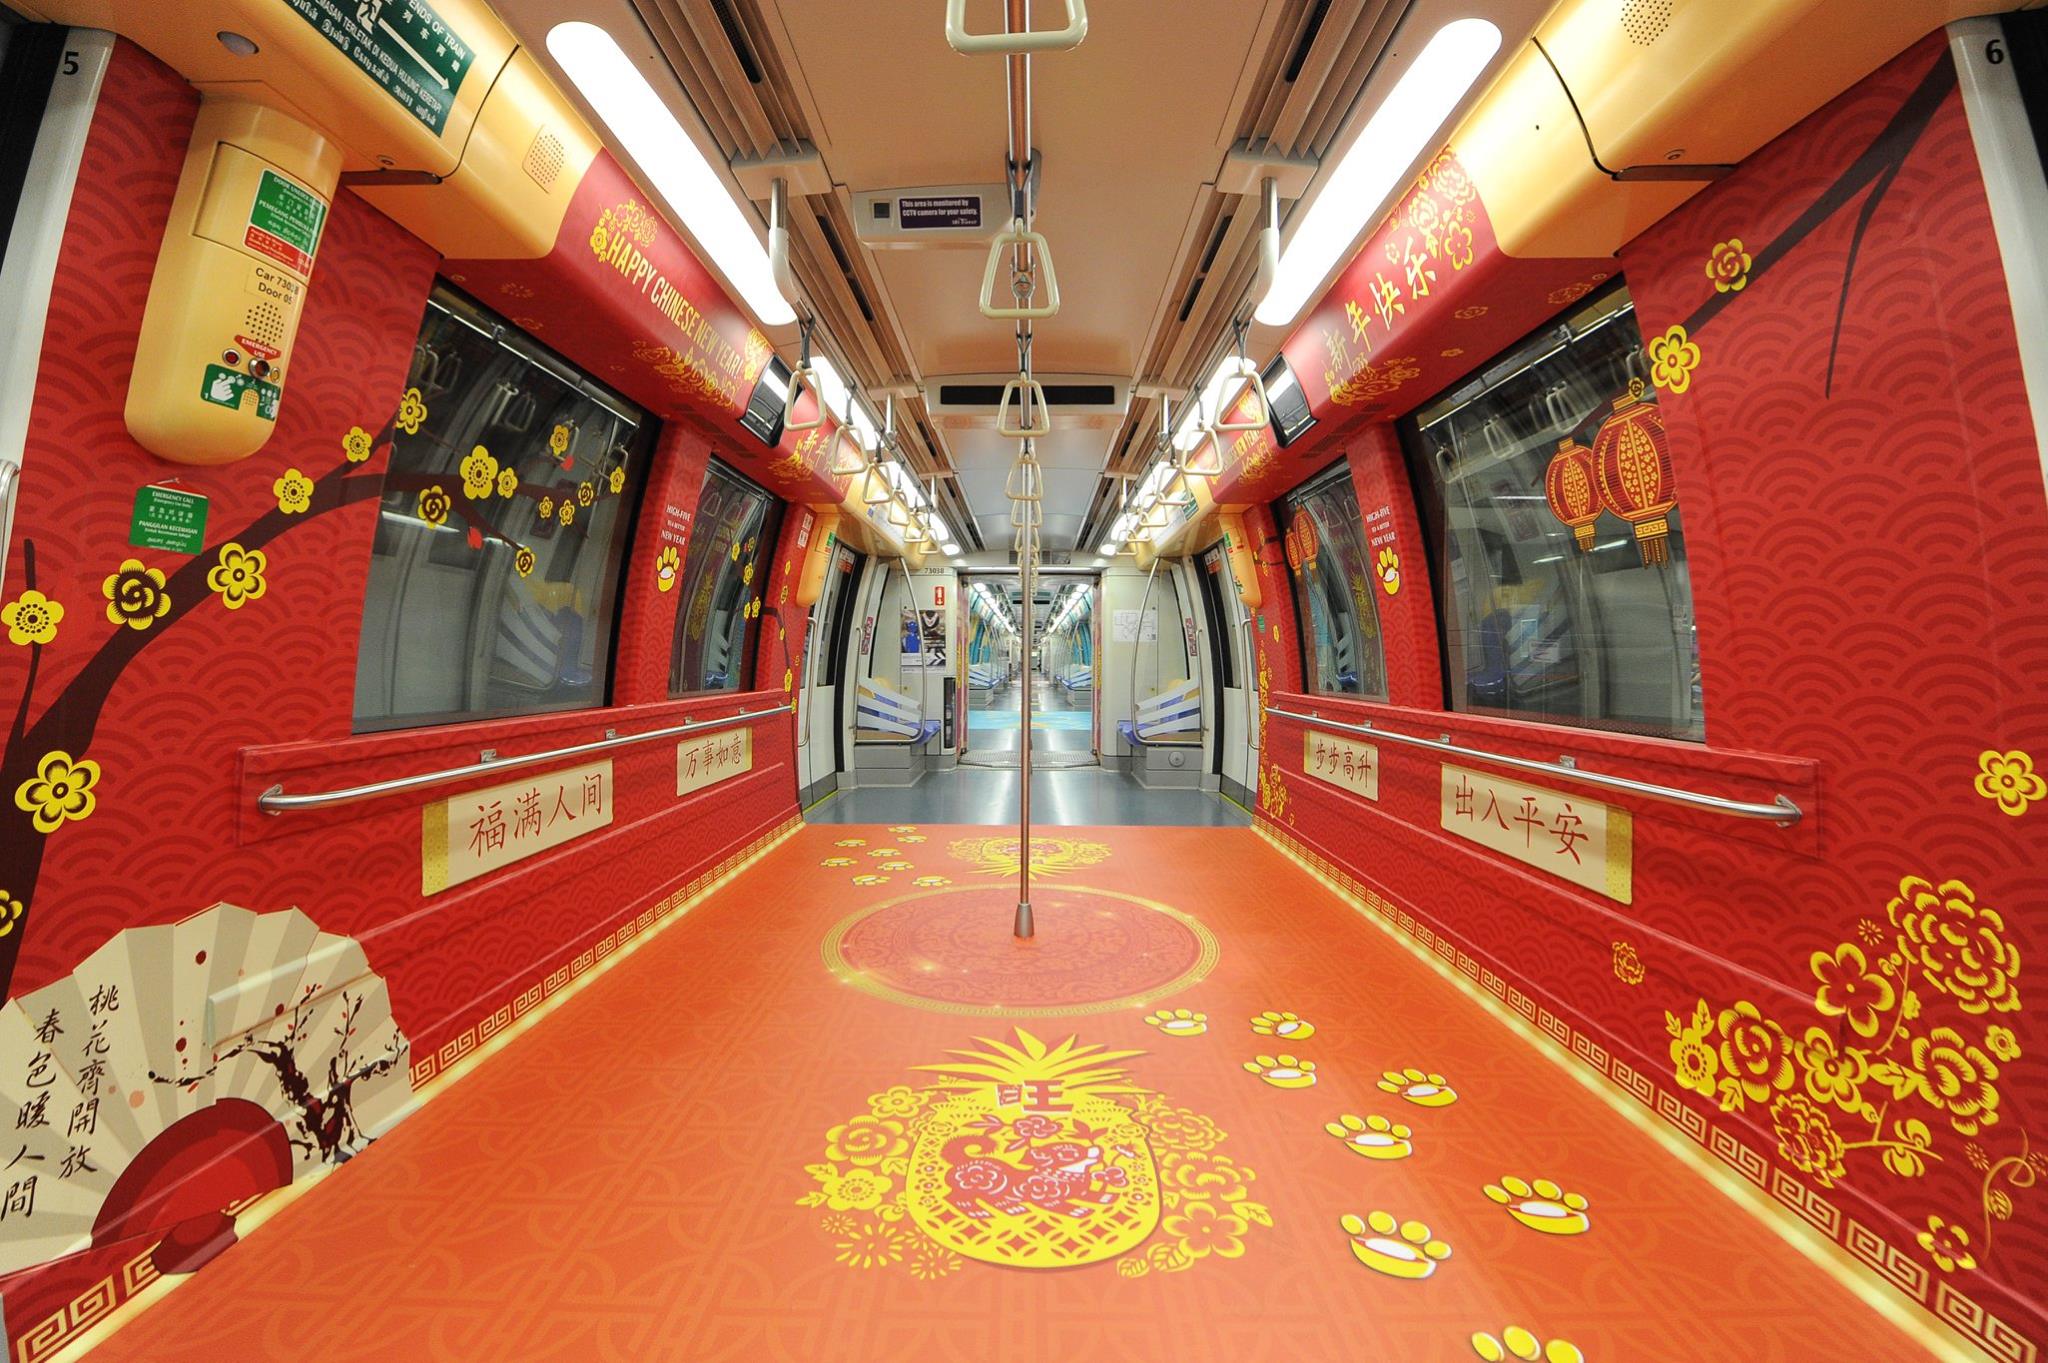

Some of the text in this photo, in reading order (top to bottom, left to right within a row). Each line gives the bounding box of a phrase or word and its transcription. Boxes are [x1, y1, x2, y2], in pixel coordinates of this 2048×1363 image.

[342, 16, 373, 50] TERLETAK
[371, 44, 381, 57] DI
[379, 50, 398, 75] KEDUA
[408, 0, 467, 59] ENDS OF TRAIN
[1986, 39, 2004, 64] 6
[63, 51, 79, 75] 5
[902, 209, 917, 217] CCTV
[933, 199, 961, 207] monitored
[962, 199, 969, 207] by
[255, 267, 274, 282] Car
[258, 281, 282, 299] Door
[606, 231, 744, 380] HAPPY CHINESE NEW YEAR!
[1322, 236, 1438, 371] 新年快乐
[240, 337, 278, 355] EMERGENCY
[152, 490, 194, 504] EMERGENCY CALL
[684, 733, 743, 779] 万事如意
[1315, 738, 1372, 789] 步步高升
[468, 773, 602, 858] 福满人间
[1455, 774, 1590, 866] 出入平安
[57, 983, 120, 1181] 桃花齊開放
[995, 1079, 1075, 1112] 旺
[0, 1007, 65, 1223] 春色暖人間
